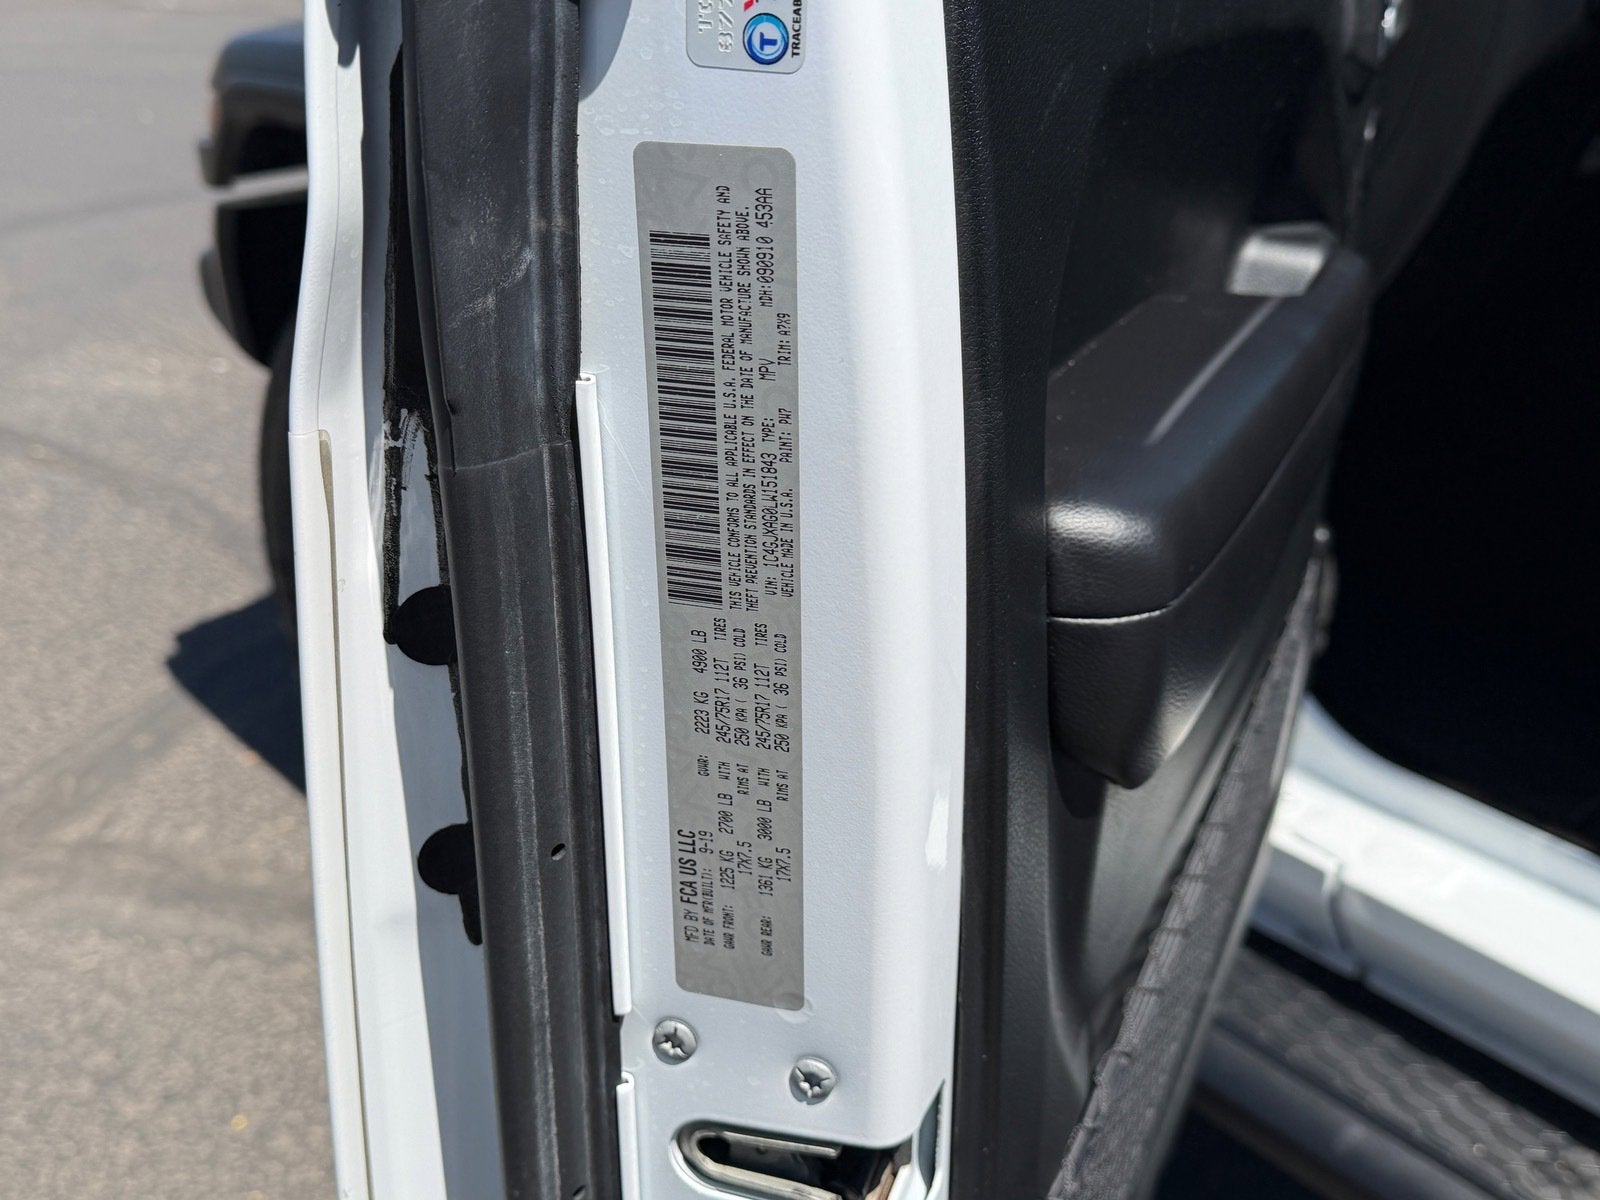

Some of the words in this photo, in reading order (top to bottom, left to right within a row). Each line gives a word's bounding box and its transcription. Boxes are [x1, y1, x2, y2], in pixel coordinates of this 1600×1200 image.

[759, 32, 778, 52] T
[716, 185, 730, 204] AND
[754, 187, 773, 229] 453AA
[717, 209, 731, 245] SAFETY
[735, 206, 750, 241] ABOVE.
[718, 250, 733, 292] VEHICLE
[736, 246, 750, 276] SHOWN
[719, 297, 734, 327] MOTOR
[737, 282, 752, 345] MANUFACTURE
[777, 312, 791, 336] A7X9
[721, 332, 736, 371] FEDERAL
[739, 351, 753, 362] OF
[778, 340, 791, 366] TRIM:
[740, 367, 754, 389] DATE
[758, 358, 776, 382] MPV
[722, 377, 737, 409] U.S.A.
[741, 394, 754, 409] THE
[742, 415, 754, 427] ON
[778, 408, 791, 425] PW7
[723, 414, 739, 467] APPLICABLE
[761, 417, 775, 442] TYPE:
[741, 431, 755, 464] EFFECT
[779, 432, 792, 463] PAINT:
[725, 472, 739, 487] ALL
[743, 468, 756, 478] IN
[726, 492, 739, 502] TO
[742, 484, 757, 530] STANDARDS
[779, 488, 794, 518] U.S.A.
[762, 452, 779, 568] 1C4GJXAG0LW151843
[726, 507, 740, 548] CONFORMS
[780, 523, 793, 532] IN
[743, 534, 758, 584] PREVENTION
[780, 538, 794, 559] MADE
[726, 552, 741, 587] VEHICLE
[780, 562, 794, 598] VEHICLE
[764, 576, 778, 596] VIN:
[728, 591, 742, 610] THIS
[745, 588, 759, 612] THEFT
[691, 629, 706, 643] LB
[714, 617, 727, 641] TIRES
[732, 628, 746, 648] COLD
[755, 623, 768, 647] TIRES
[774, 633, 787, 653] COLD
[692, 648, 707, 674] 4900
[713, 657, 729, 683] 112T
[733, 653, 746, 671] PSI)
[774, 658, 787, 677] PSI)
[732, 677, 748, 690] 36
[753, 663, 770, 689] 112T
[693, 691, 709, 705] KG
[773, 682, 789, 697] 36
[694, 709, 710, 735] 2223
[714, 688, 731, 744] 245/75R17
[735, 708, 747, 722] KPA
[754, 694, 771, 750] 245/75R17
[775, 714, 788, 729] KPA
[734, 727, 750, 747] 250
[774, 734, 790, 753] 250
[697, 754, 710, 777] GVWR:
[718, 762, 730, 780] WITH
[736, 763, 749, 773] AT
[776, 769, 788, 780] AT
[737, 777, 749, 795] RIMS
[757, 767, 770, 787] WITH
[717, 793, 733, 806] LB
[776, 783, 789, 802] RIMS
[756, 799, 772, 813] LB
[718, 810, 734, 835] 2700
[757, 817, 772, 841] 3000
[677, 829, 696, 854] LLC
[698, 830, 713, 855] 9-19
[678, 857, 697, 876] US
[719, 850, 734, 864] KG
[737, 840, 753, 876] 17X7.5
[758, 856, 773, 870] KG
[775, 847, 792, 882] 17X7.5
[720, 867, 735, 890] 1225
[758, 875, 774, 897] 1361
[679, 880, 697, 905] FCA
[683, 908, 698, 922] BY
[703, 917, 714, 926] OF
[722, 905, 735, 930] FRONT:
[683, 925, 700, 942] MFD
[760, 916, 773, 937] REAR:
[703, 930, 715, 946] DATE
